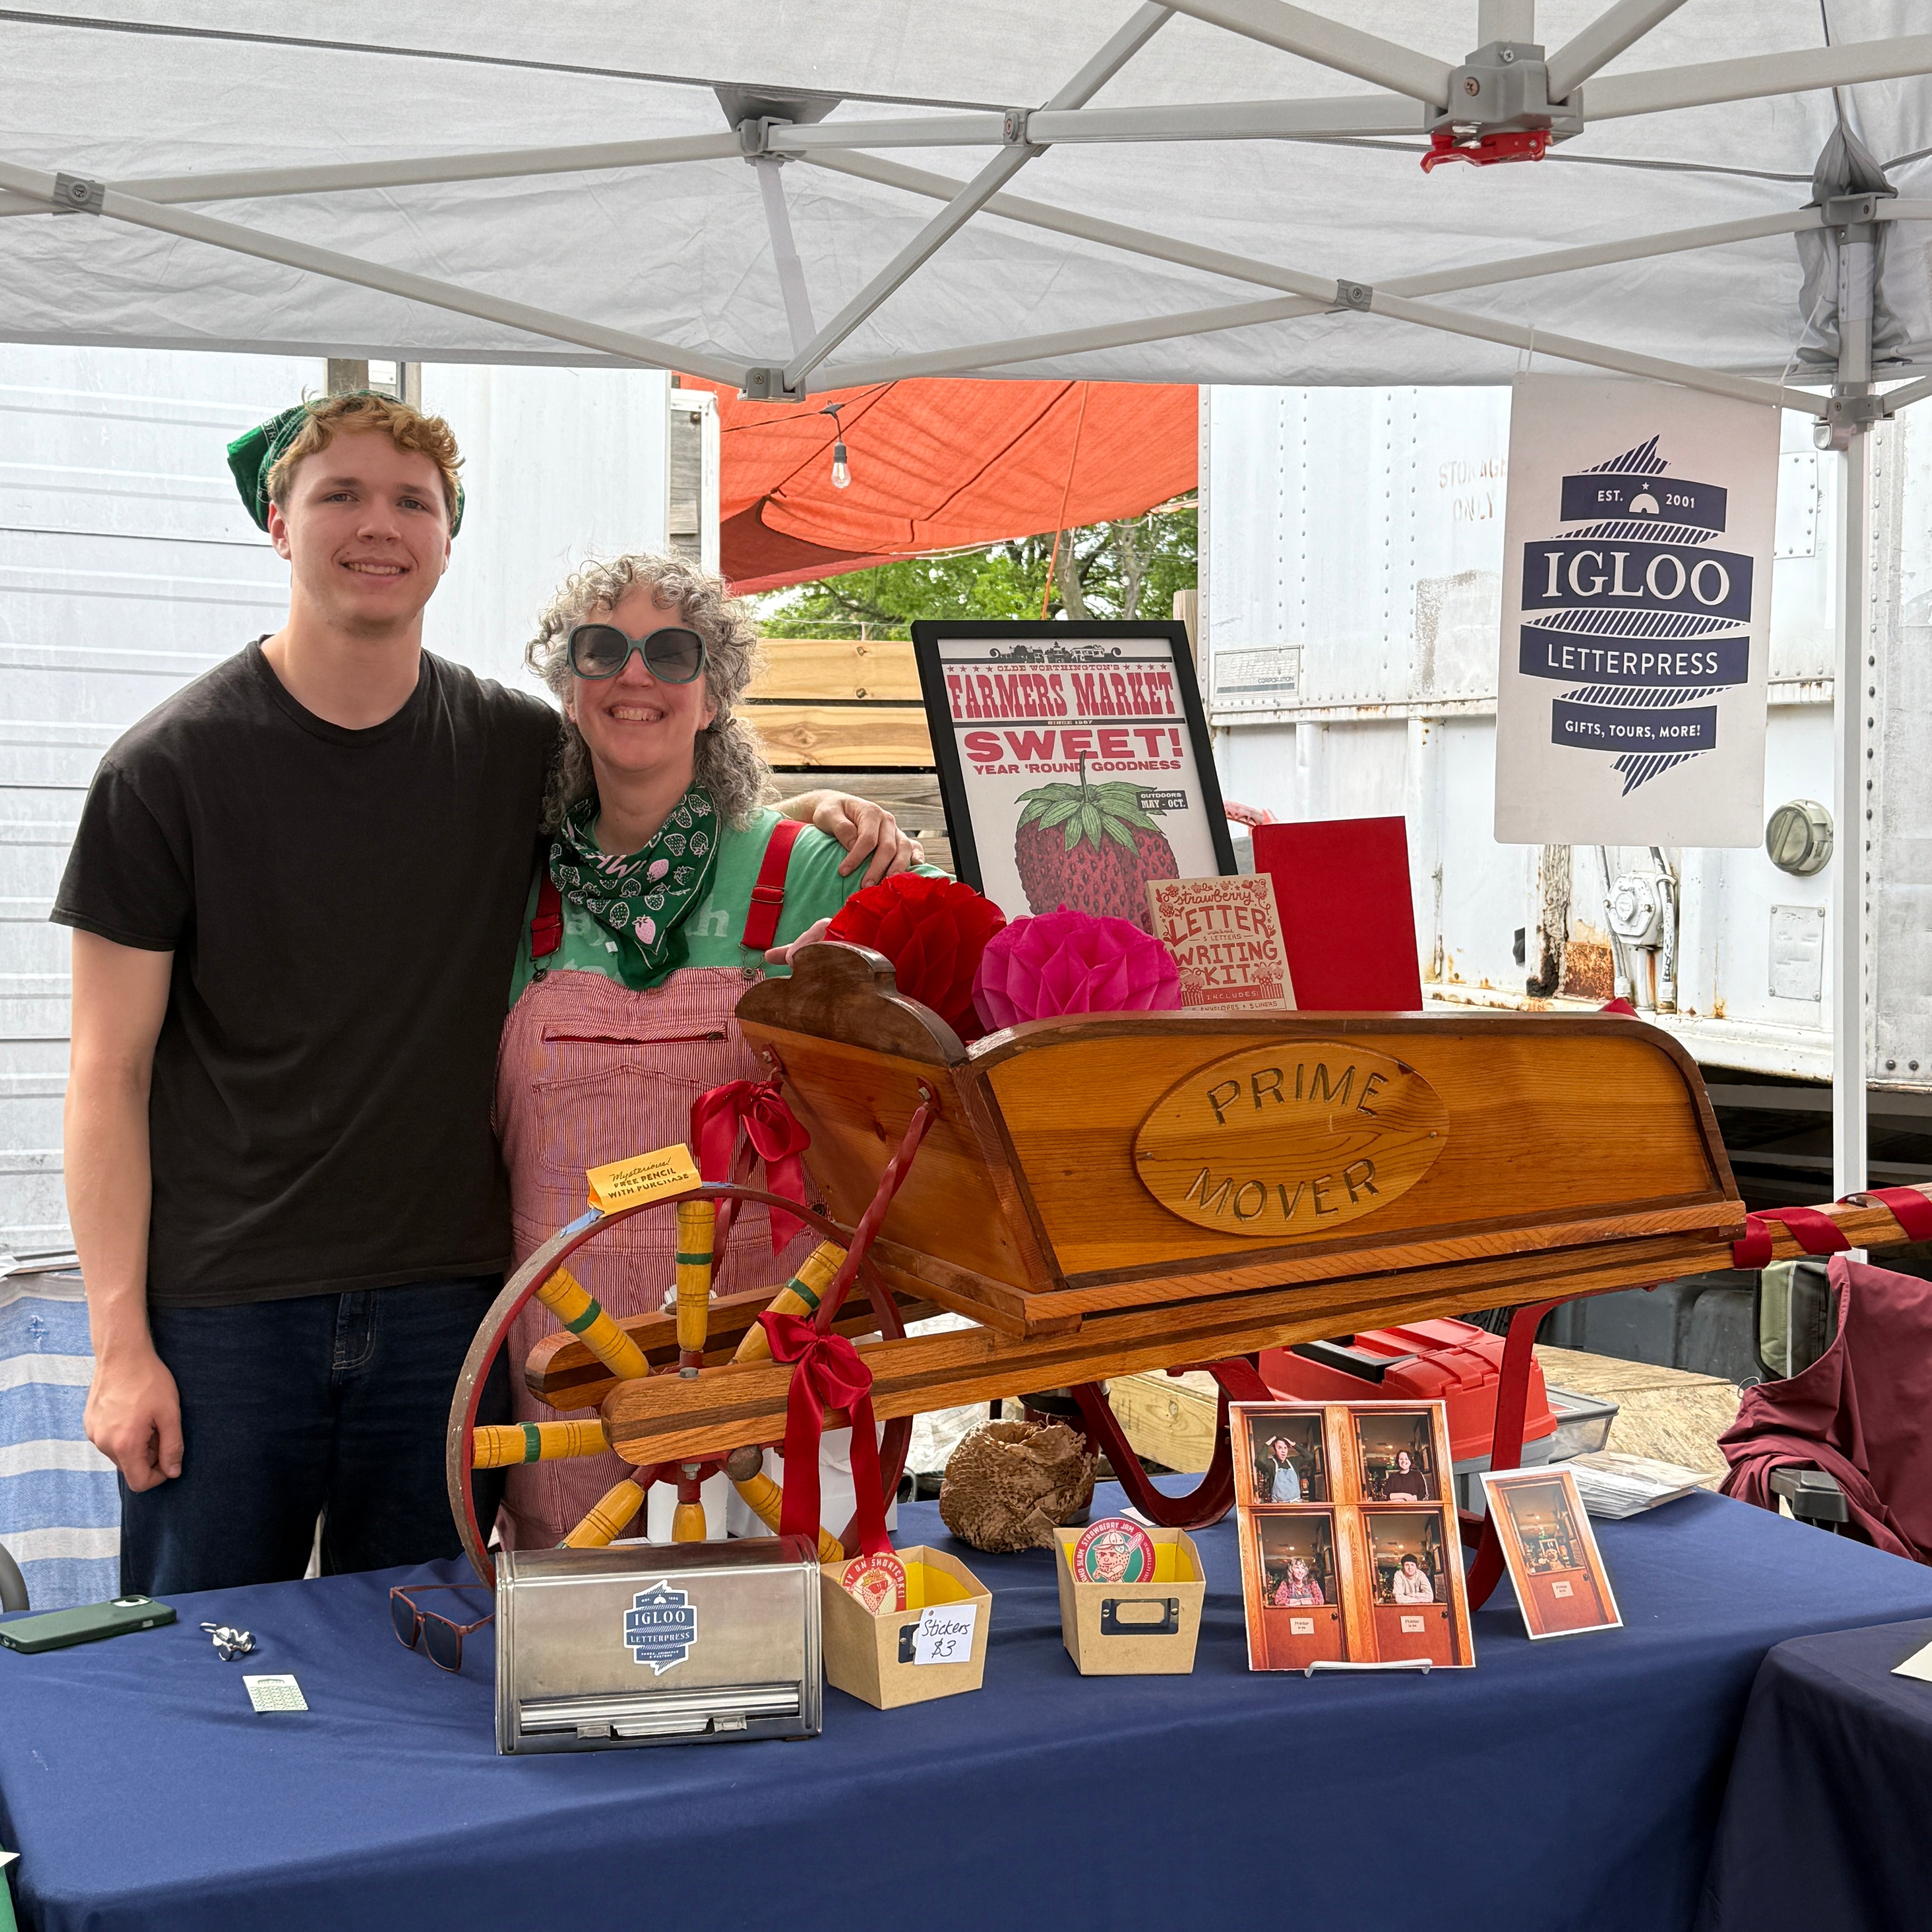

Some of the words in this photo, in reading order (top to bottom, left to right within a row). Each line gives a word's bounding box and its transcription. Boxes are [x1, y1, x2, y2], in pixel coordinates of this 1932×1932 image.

[1597, 490, 1623, 503] EST.
[1666, 493, 1695, 509] 2001
[1541, 549, 1730, 606] IGLOO
[1547, 643, 1719, 675] LETTERPRESS
[947, 674, 1067, 718] FARMERS
[1071, 672, 1175, 717] MARKET
[1564, 720, 1605, 738] GIFTS,
[1609, 723, 1655, 740] TOURS,
[1659, 724, 1701, 738] MORE!
[964, 728, 1183, 762] SWEET!
[973, 763, 1019, 775] YEAR
[1025, 762, 1086, 774] 'ROUND
[1091, 760, 1181, 771] GOODNESS
[1141, 800, 1160, 809] MAY
[1167, 798, 1186, 808] OCT.
[1163, 905, 1269, 947] LETTER
[1169, 940, 1277, 966] WRITING
[1203, 964, 1252, 986] KIT
[1207, 1063, 1389, 1126] PRIME
[609, 1156, 671, 1182] Mysterious!
[614, 1179, 639, 1188] FREE
[640, 1167, 677, 1182] PENCIL
[608, 1188, 635, 1199] WITH
[637, 1173, 689, 1192] PURCHASE
[1184, 1158, 1379, 1222] MOVER
[1077, 1548, 1085, 1567] SLAM
[1081, 1522, 1119, 1547] STRAWBERRY
[1120, 1523, 1135, 1533] JAM
[854, 1560, 867, 1572] ON
[635, 1610, 686, 1626] IGLOO
[922, 1620, 971, 1637] Stickers
[630, 1632, 690, 1643] LETTERPRESS
[931, 1637, 956, 1659] $3
